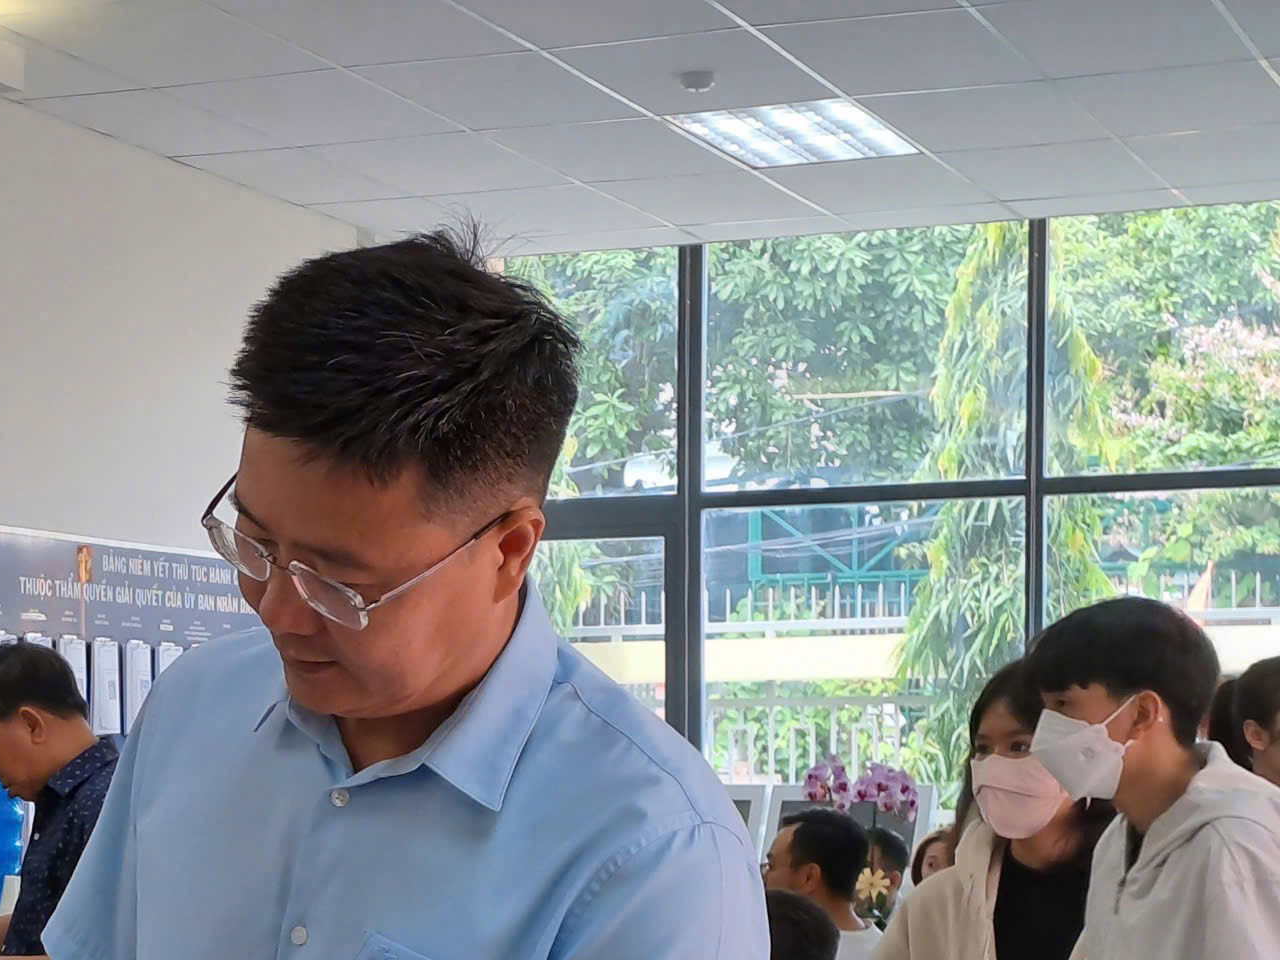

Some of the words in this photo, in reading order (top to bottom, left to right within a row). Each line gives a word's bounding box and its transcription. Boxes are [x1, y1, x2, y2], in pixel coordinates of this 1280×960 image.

[102, 549, 127, 573] BẢNG
[19, 573, 52, 600] THUỘC
[55, 572, 81, 599] THẨM
[116, 580, 133, 604] GIẢI
[198, 593, 214, 611] BAN
